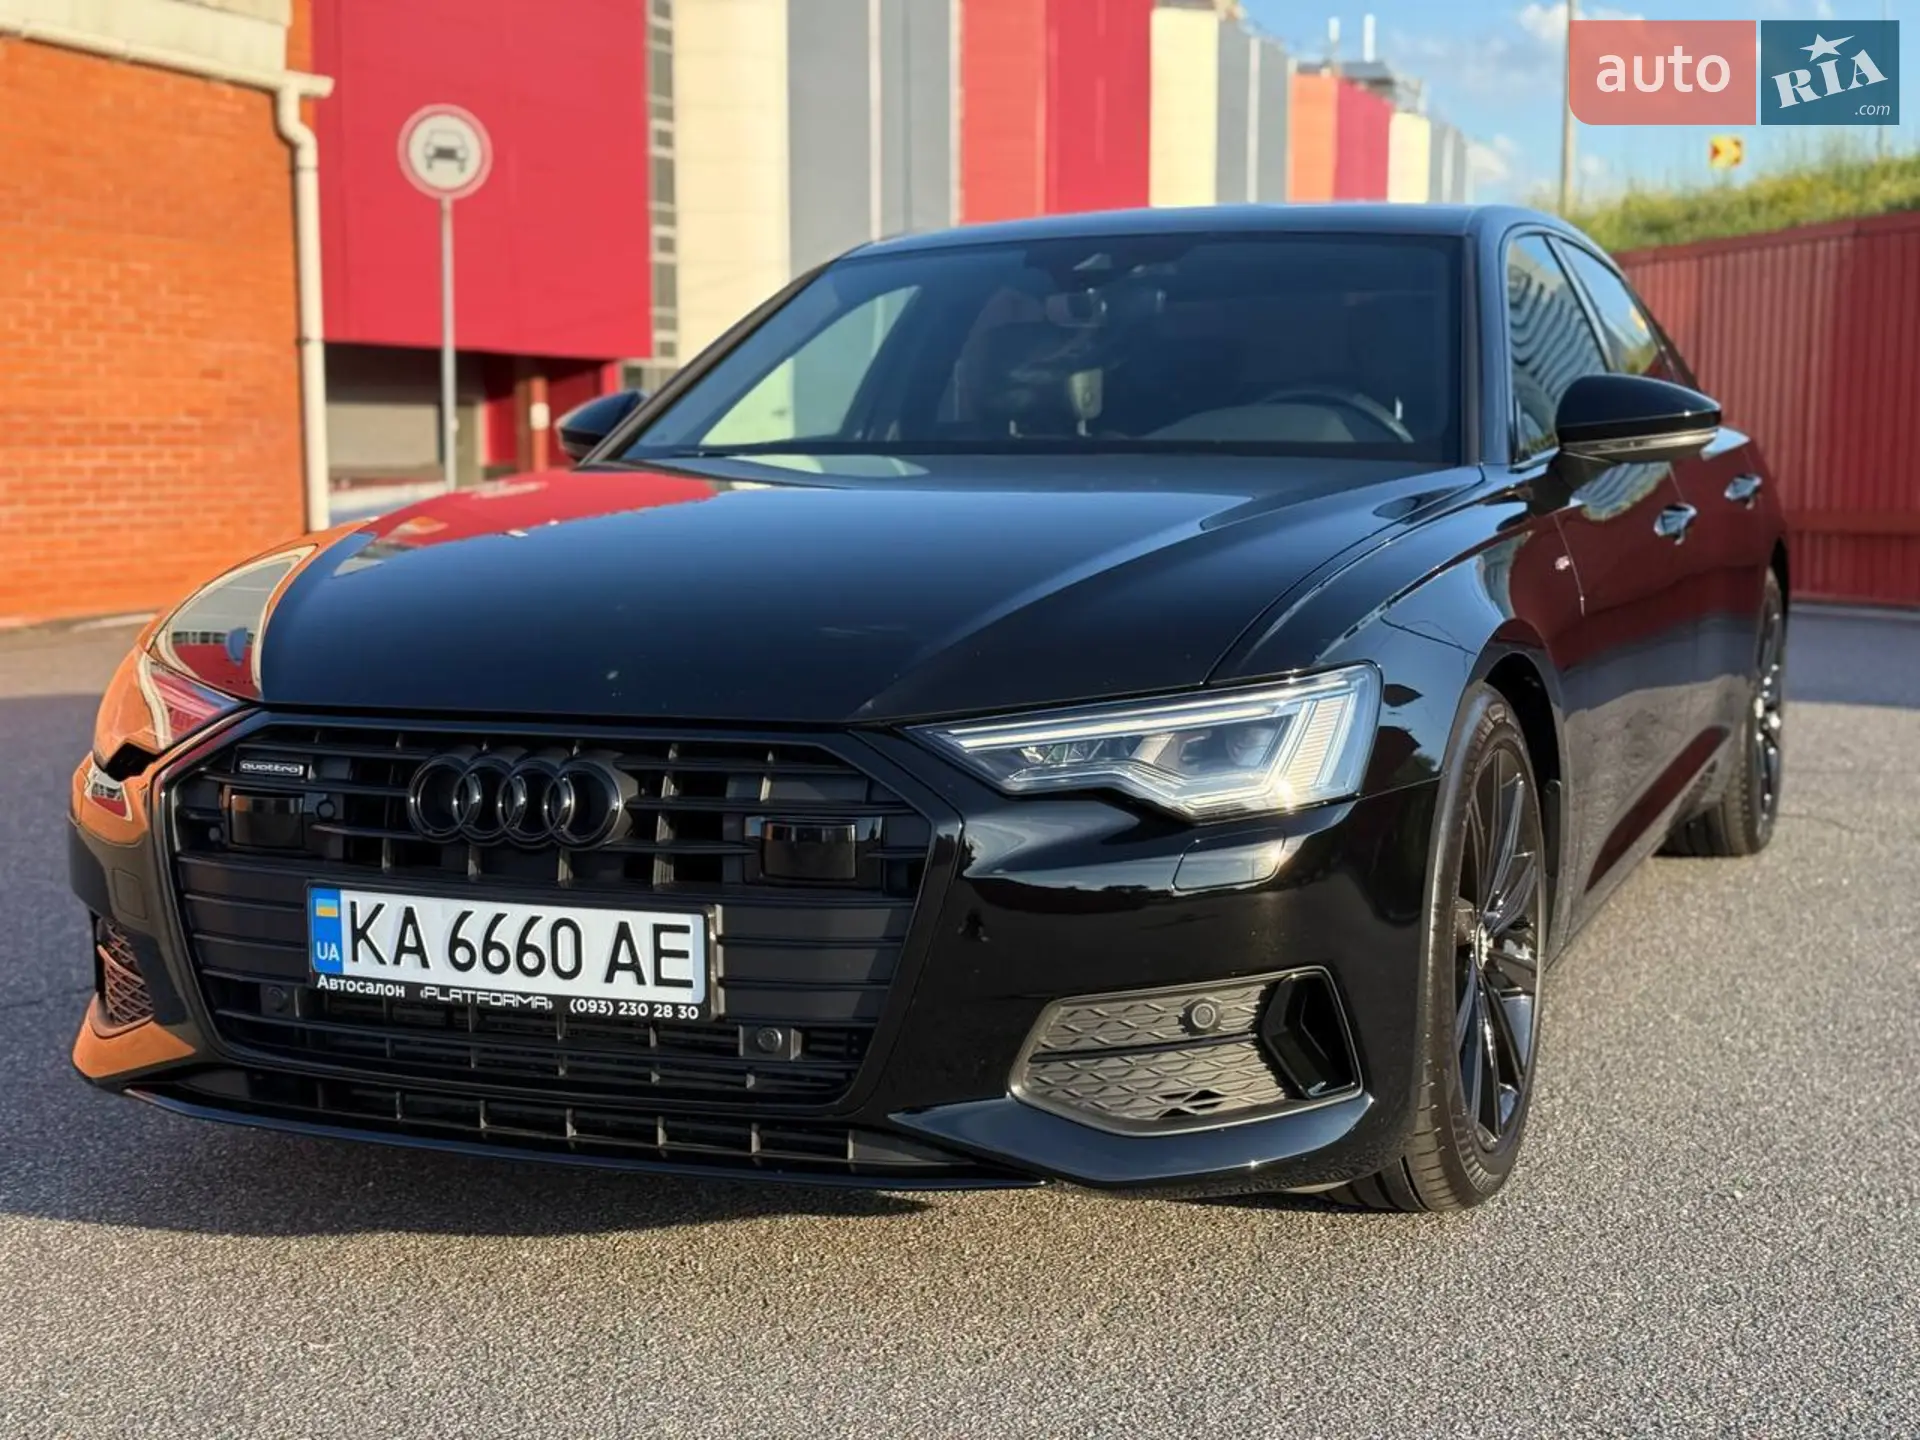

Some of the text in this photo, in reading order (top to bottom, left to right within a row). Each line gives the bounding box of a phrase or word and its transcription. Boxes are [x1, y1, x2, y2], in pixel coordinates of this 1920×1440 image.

[241, 762, 299, 774] quattro
[317, 940, 340, 962] UA
[349, 900, 694, 988] KA 6660 AE
[317, 974, 405, 998] Автосалон
[569, 998, 614, 1016] (093)
[618, 1001, 649, 1017] 230
[653, 1004, 673, 1018] 28
[678, 1005, 699, 1020] 30
